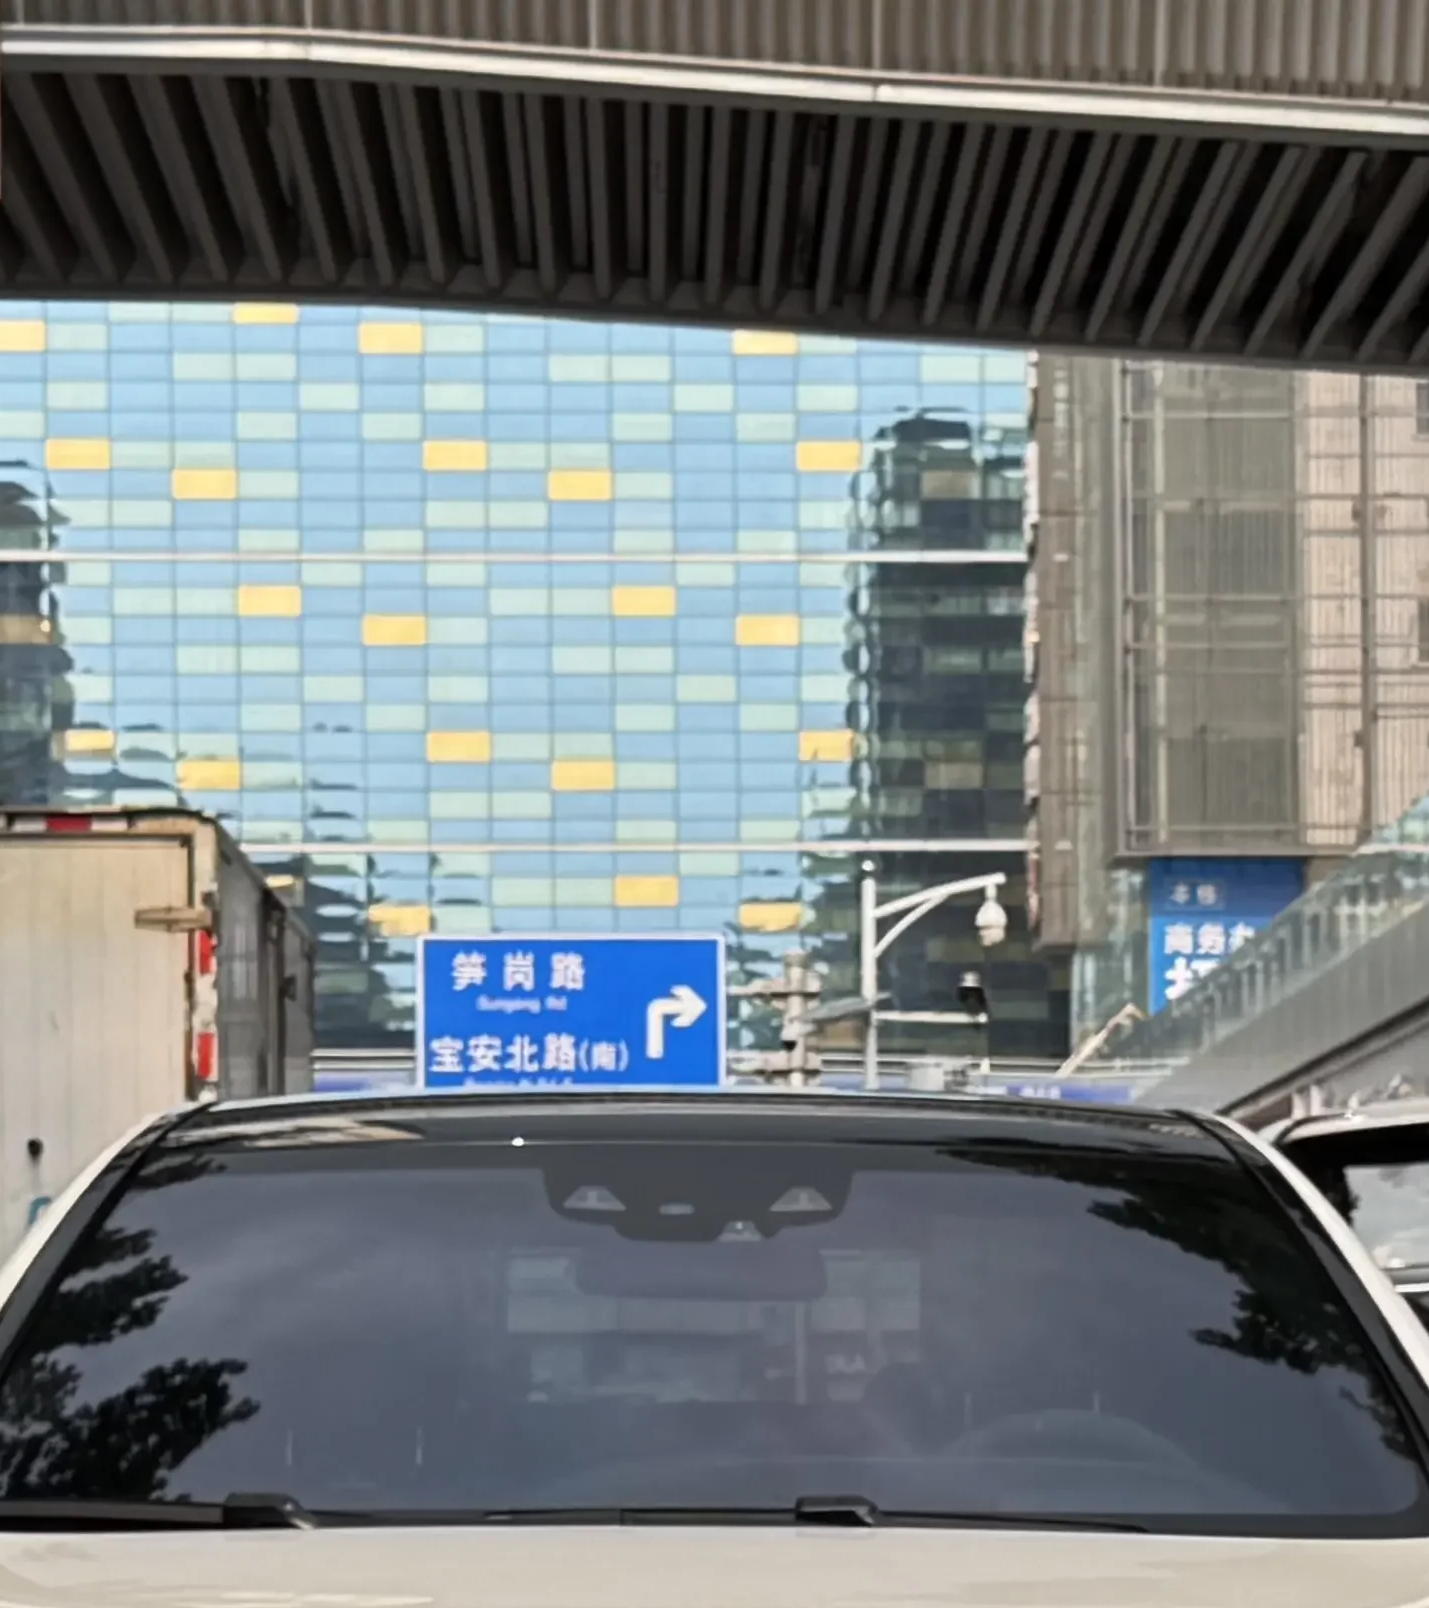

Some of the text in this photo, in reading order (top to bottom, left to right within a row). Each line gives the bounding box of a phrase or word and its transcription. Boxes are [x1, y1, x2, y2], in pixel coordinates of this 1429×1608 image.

[451, 949, 586, 992] 笋岗路
[429, 1032, 630, 1074] 宝安北路(南)
